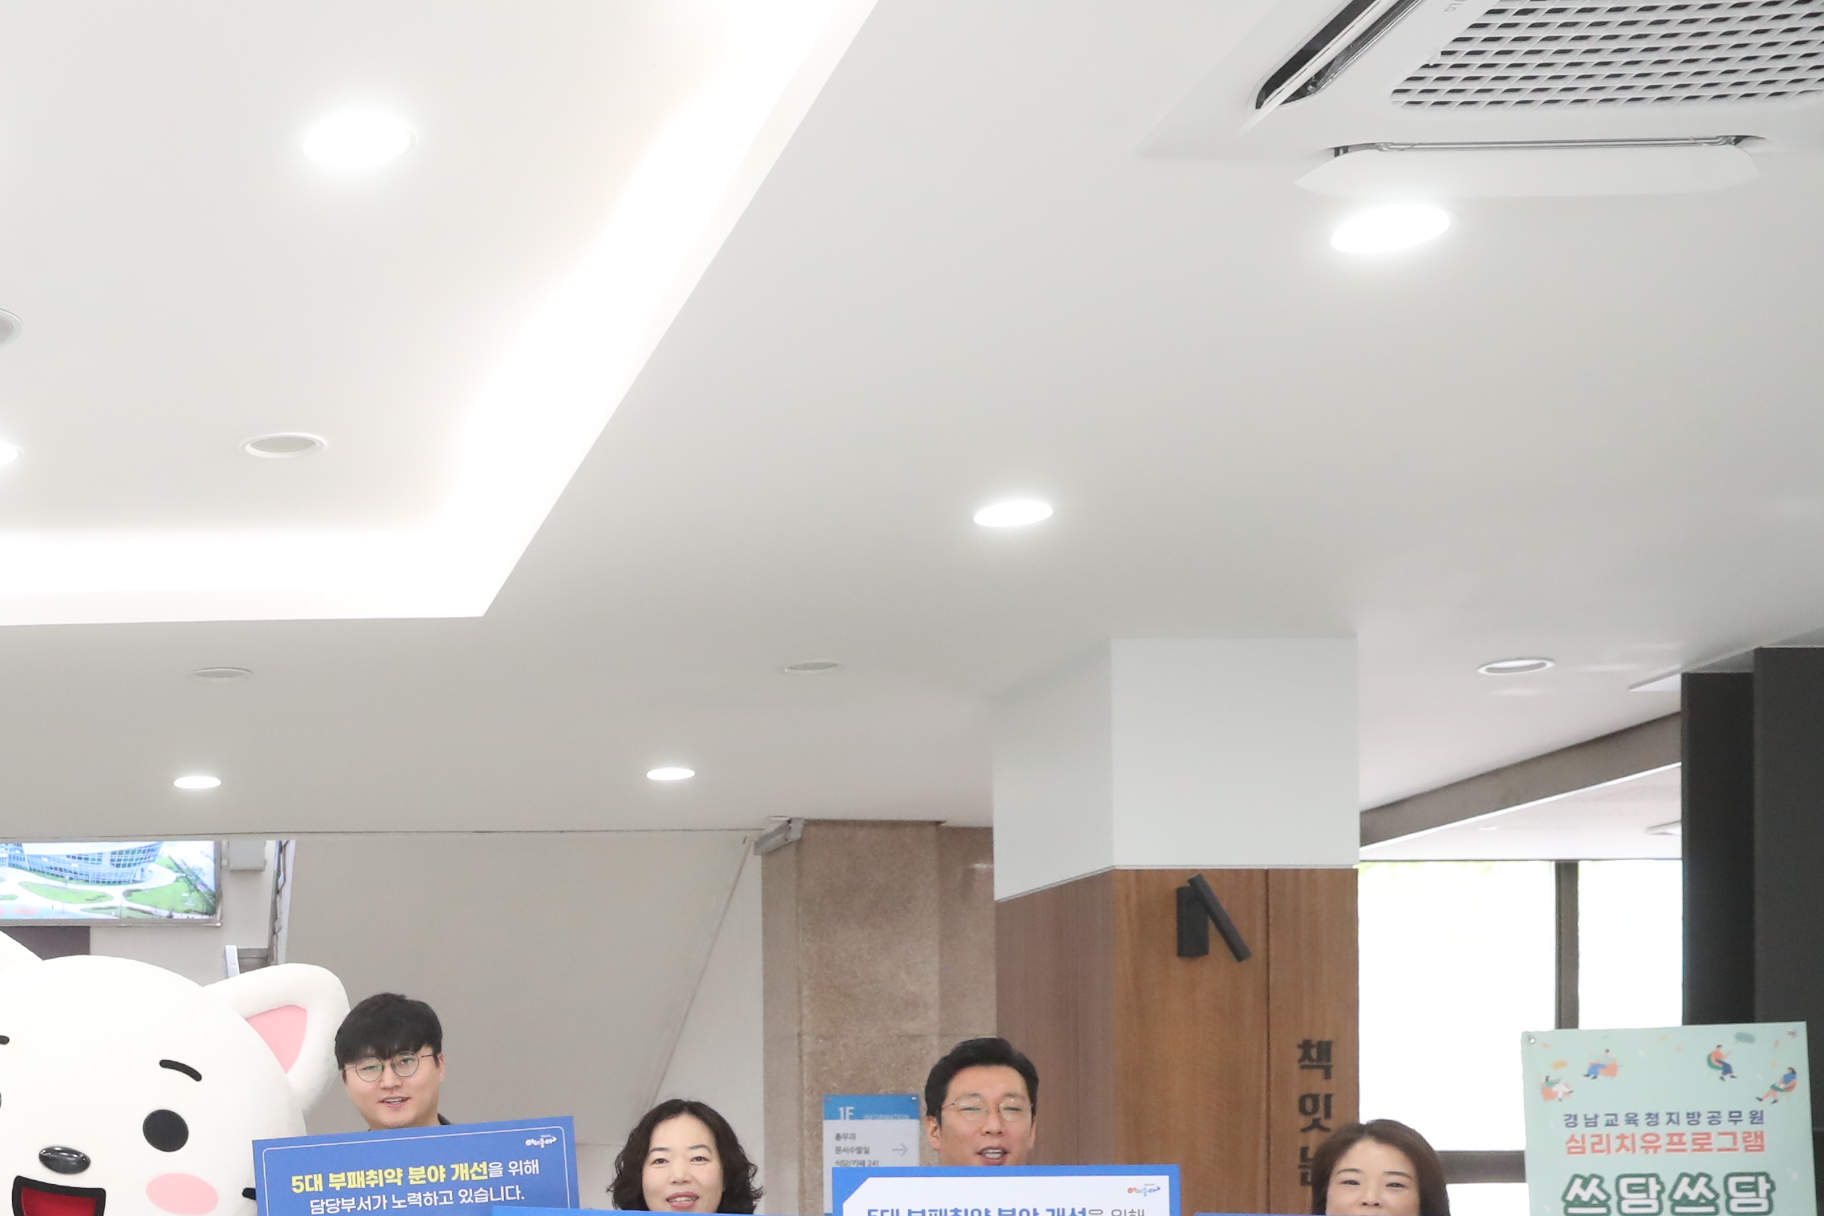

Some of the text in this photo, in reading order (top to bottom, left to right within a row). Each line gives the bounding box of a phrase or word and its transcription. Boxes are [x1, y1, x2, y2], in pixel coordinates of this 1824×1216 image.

[839, 1106, 854, 1120] 1F
[1565, 1130, 1766, 1155] 심리치유프로그램
[291, 1159, 540, 1194] 5대 부패취약 분야 개선을 위해
[310, 1184, 525, 1215] 담당부서가 노력하고 있습니다.
